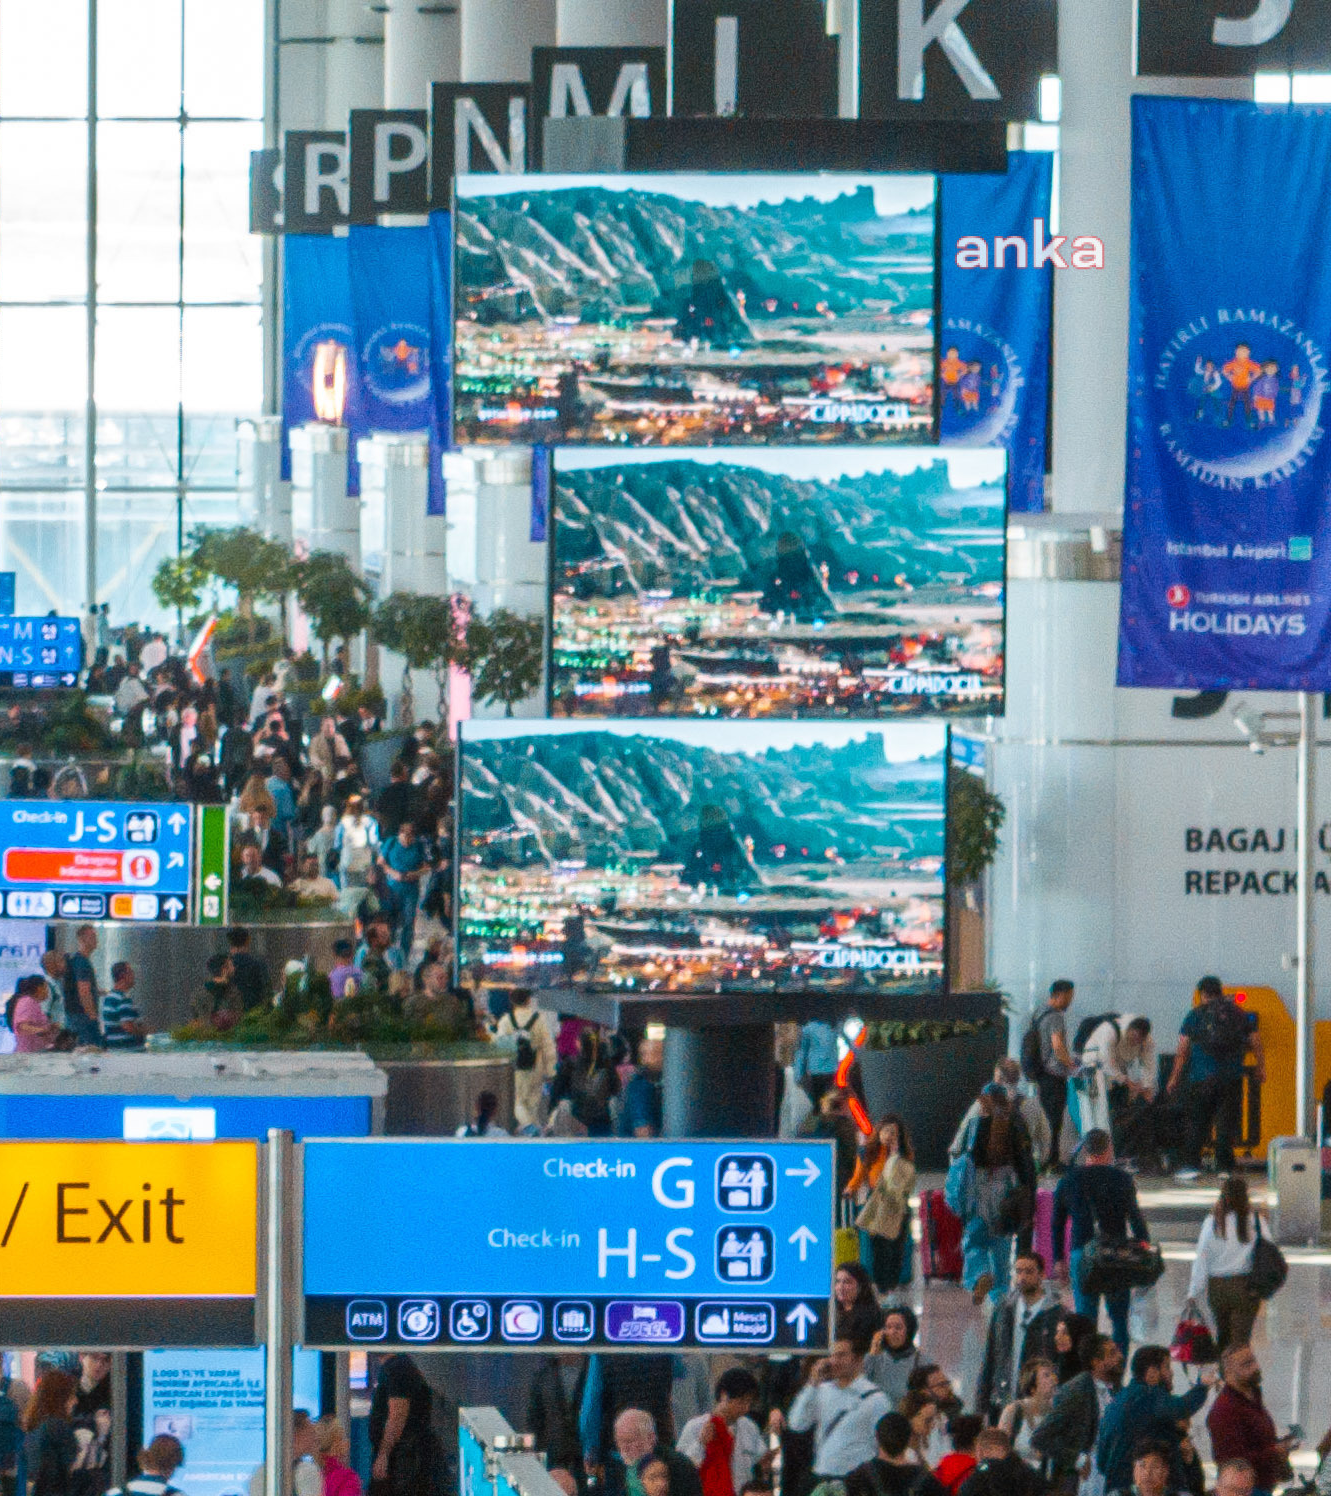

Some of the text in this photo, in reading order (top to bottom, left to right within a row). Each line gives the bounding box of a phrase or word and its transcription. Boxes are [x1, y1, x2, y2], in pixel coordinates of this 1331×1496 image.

[454, 98, 525, 173] N
[374, 122, 426, 202] P
[304, 142, 350, 215] R
[13, 622, 33, 640] M
[1169, 610, 1307, 636] HOLIDAYS
[12, 810, 118, 843] Check-in J-S
[1184, 827, 1286, 853] BAGAJ
[818, 948, 923, 969] CAPPADOCIA
[542, 1156, 696, 1210] Check-in G
[0, 1181, 30, 1248] /
[55, 1182, 186, 1245] Exit
[487, 1227, 697, 1280] Check-in H-S
[351, 1312, 383, 1327] ATM
[733, 1311, 767, 1323] Mescit
[733, 1322, 767, 1336] Masjid
